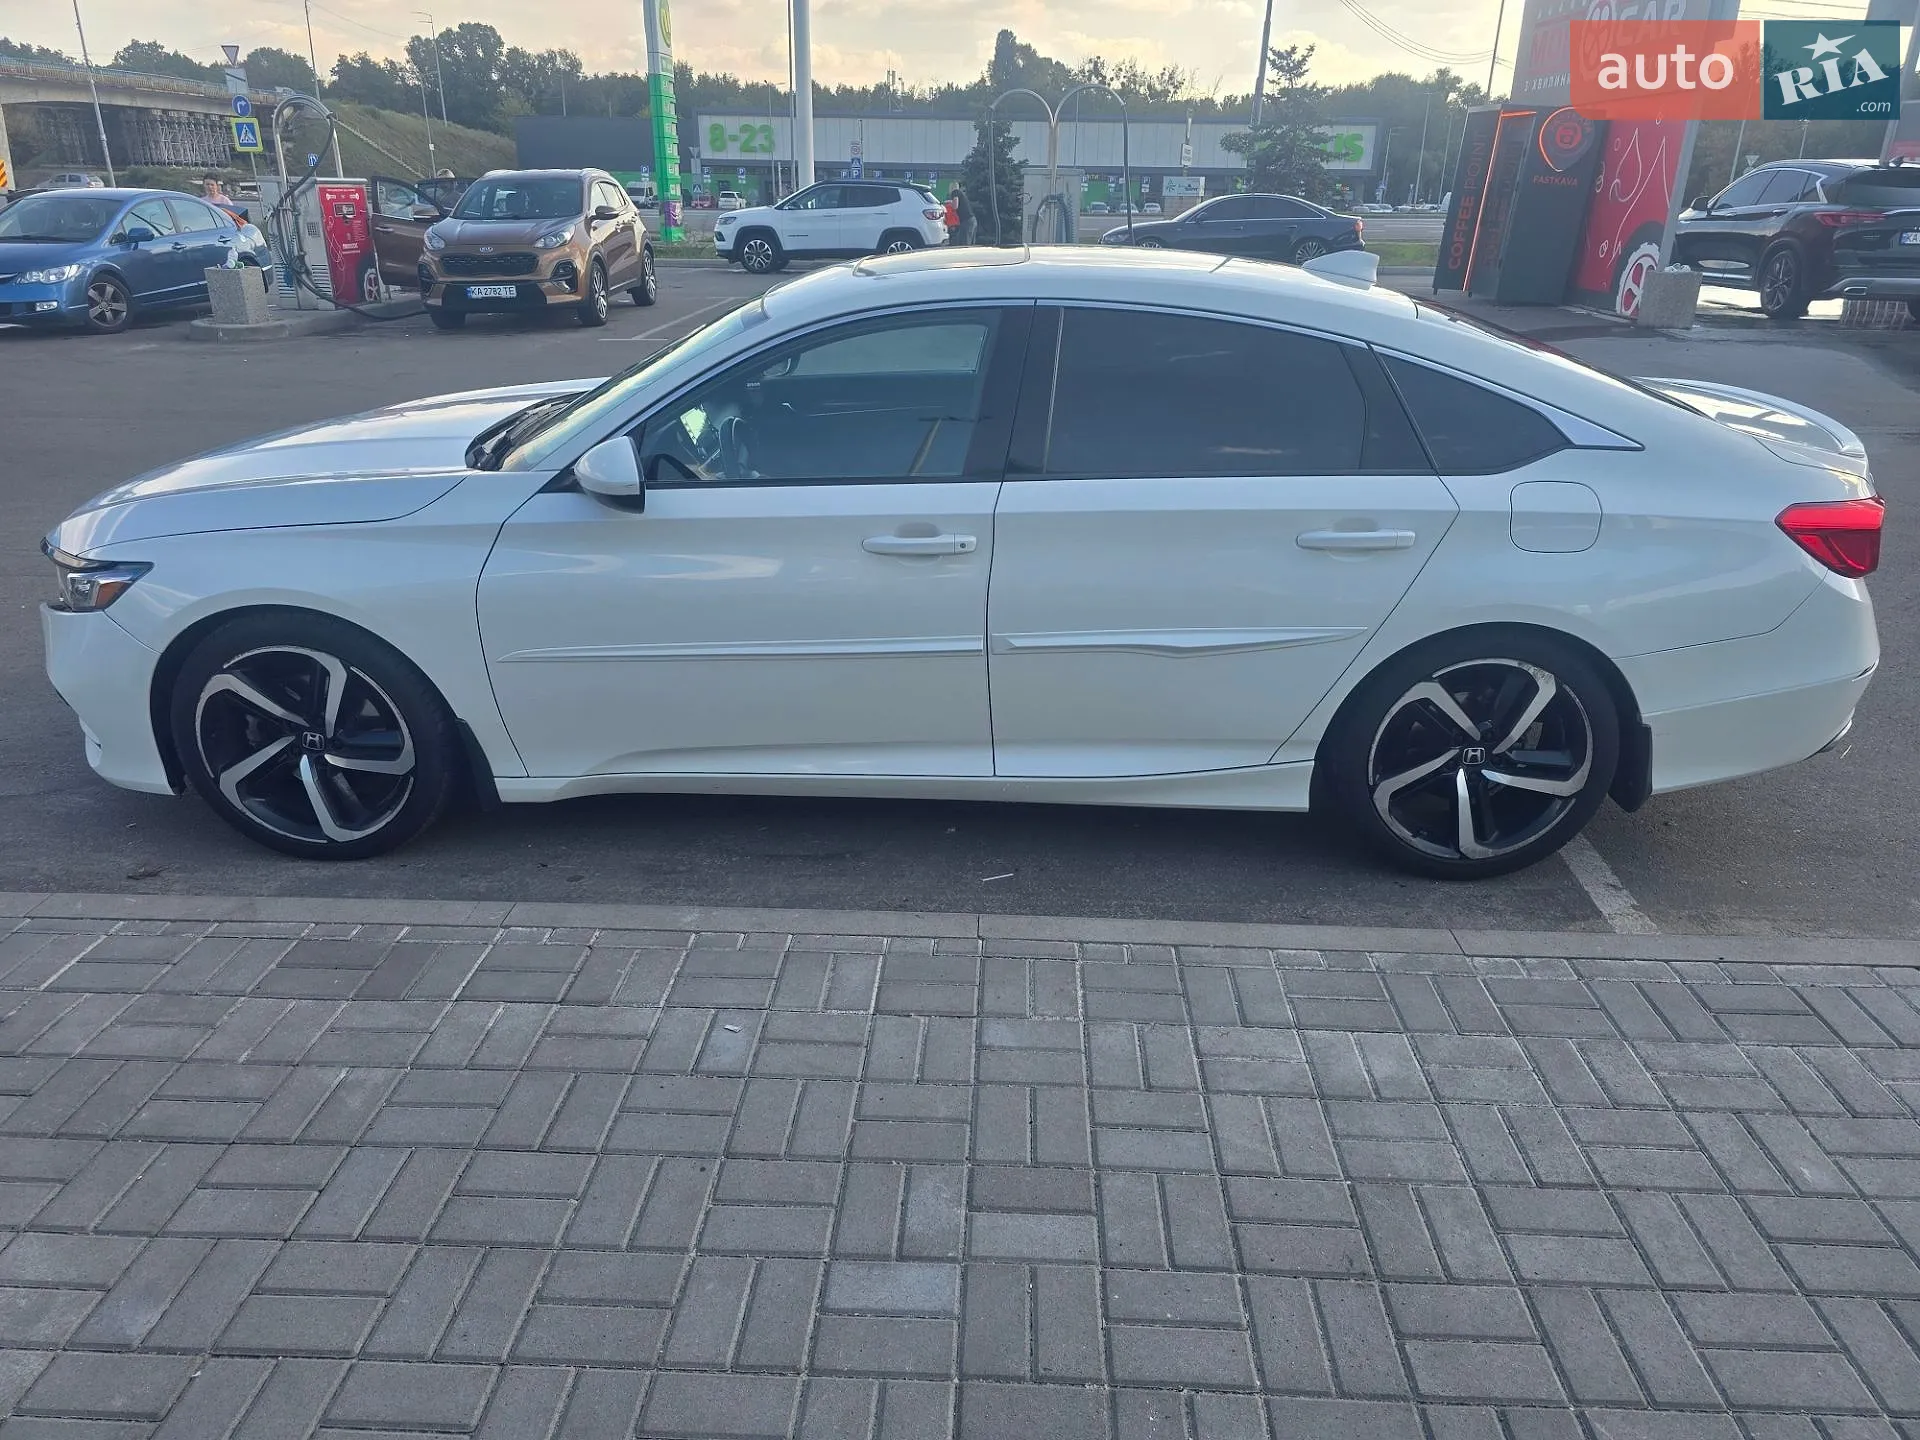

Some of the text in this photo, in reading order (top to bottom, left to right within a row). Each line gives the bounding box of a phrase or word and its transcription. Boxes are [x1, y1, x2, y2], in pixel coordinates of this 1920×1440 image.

[709, 123, 774, 153] 8-23
[1533, 175, 1578, 187] FASTKAVA
[1448, 130, 1488, 270] COFFEE POINT
